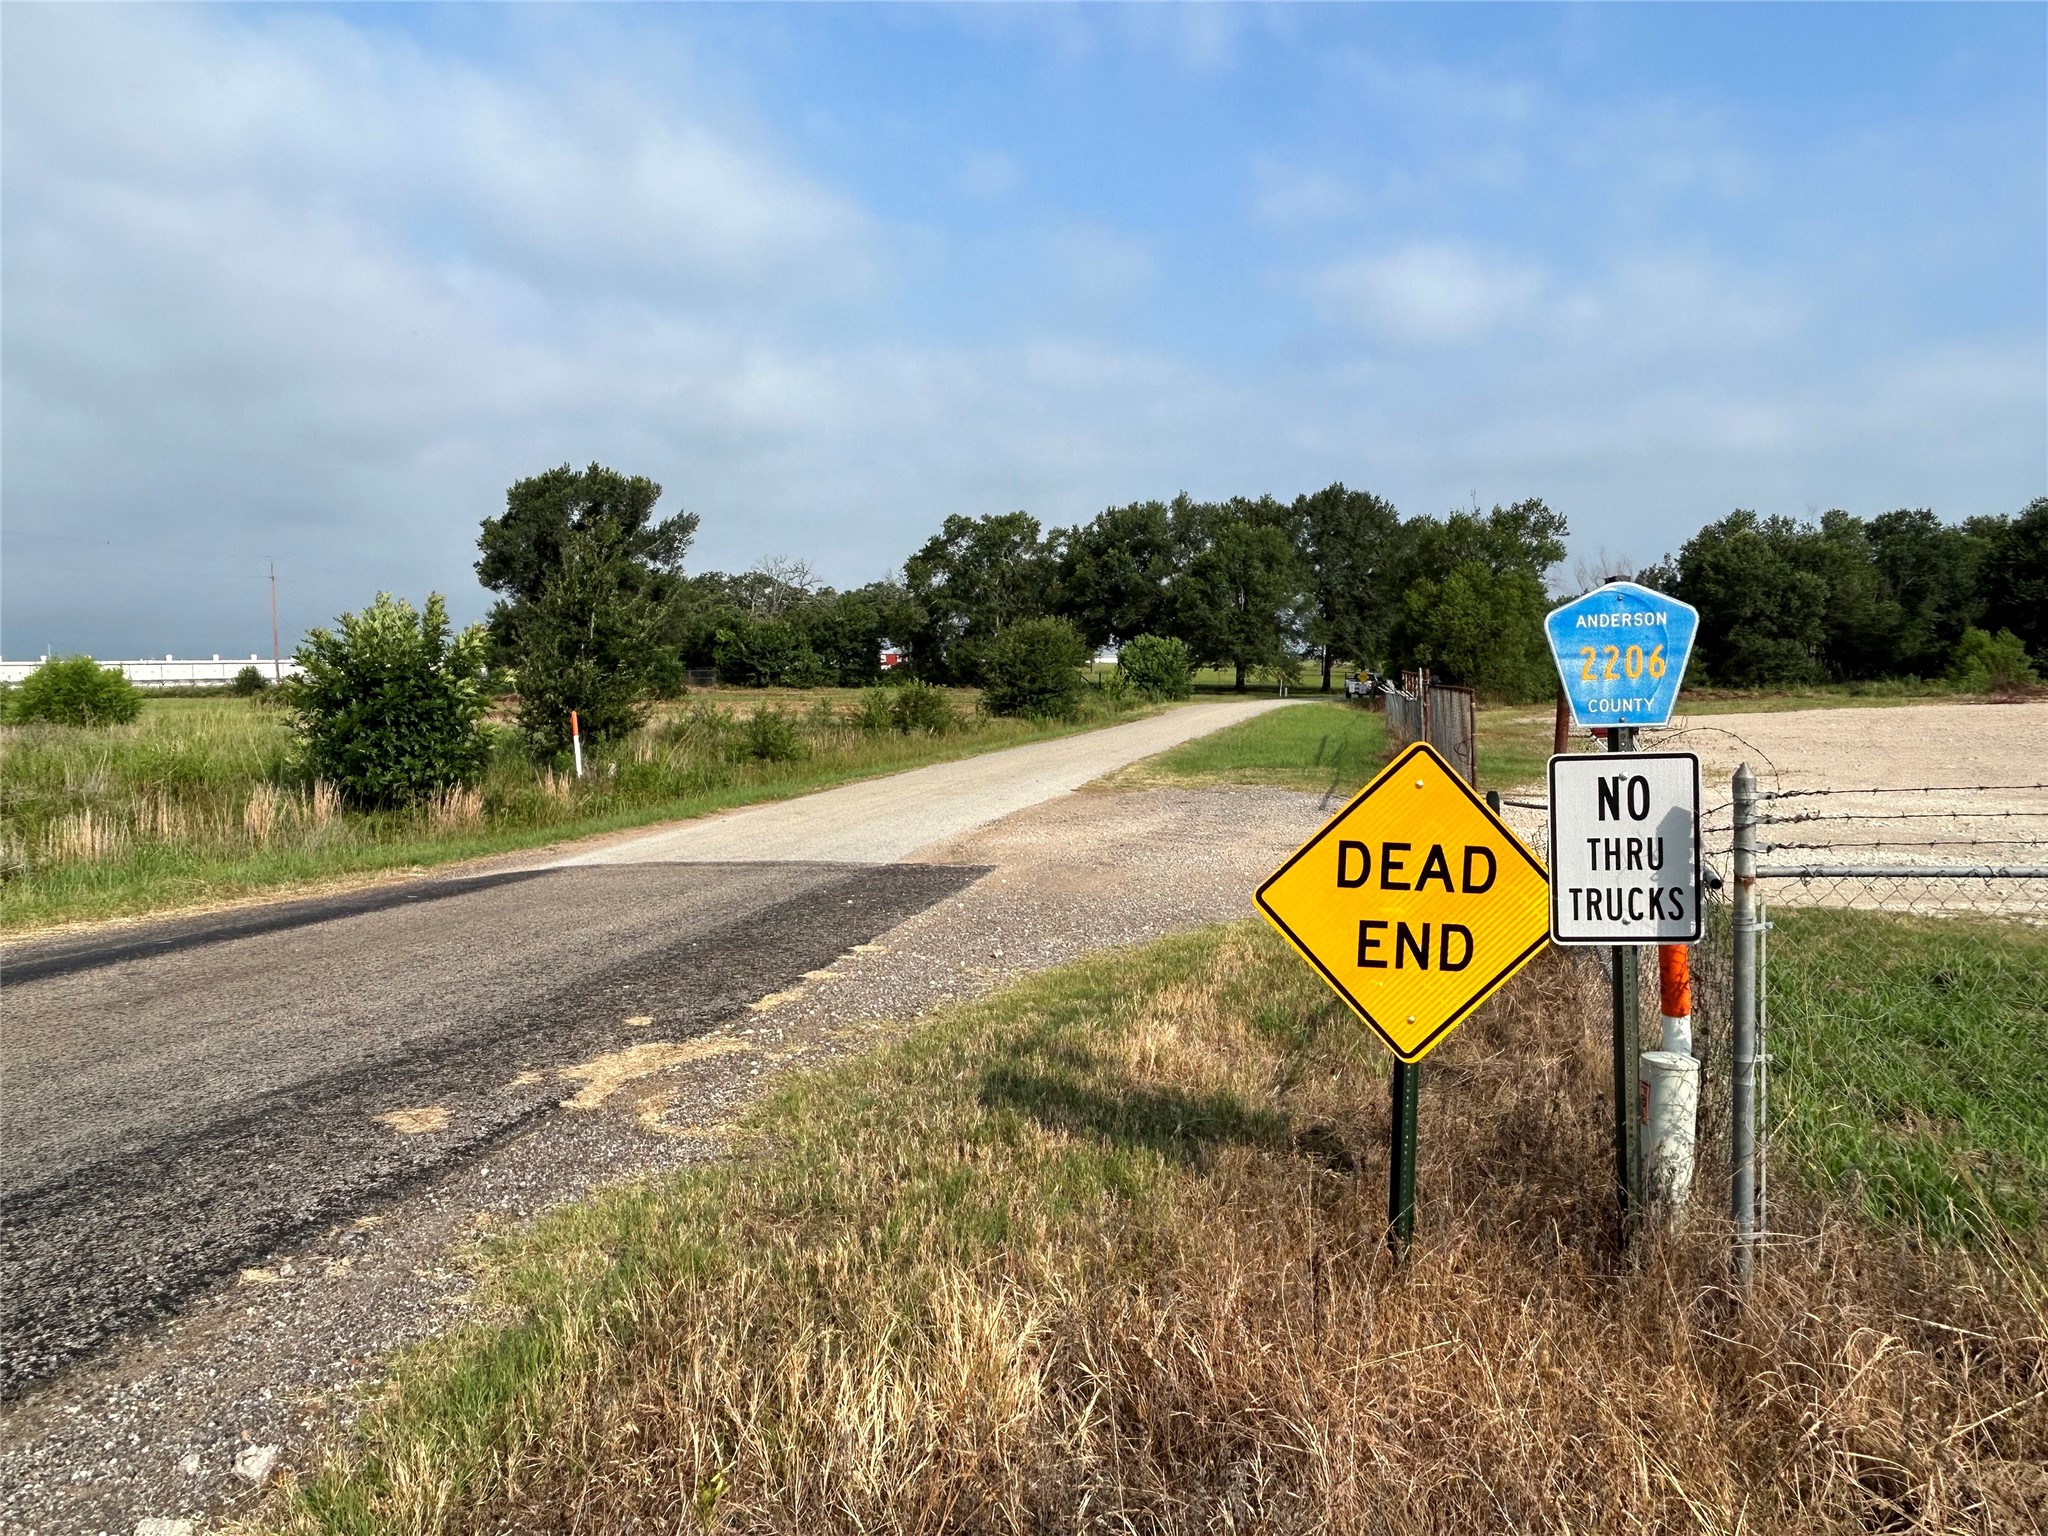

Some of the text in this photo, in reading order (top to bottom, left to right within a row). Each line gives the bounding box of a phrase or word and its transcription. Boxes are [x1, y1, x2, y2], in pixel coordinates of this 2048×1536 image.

[1576, 612, 1667, 628] ANDERSON
[1580, 645, 1666, 681] 2206
[1588, 698, 1654, 712] COUNTY
[1598, 775, 1650, 821] NO
[1336, 840, 1498, 894] DEAD
[1587, 836, 1664, 870] THRU
[1569, 887, 1684, 921] TRUCKS
[1357, 919, 1474, 972] END
